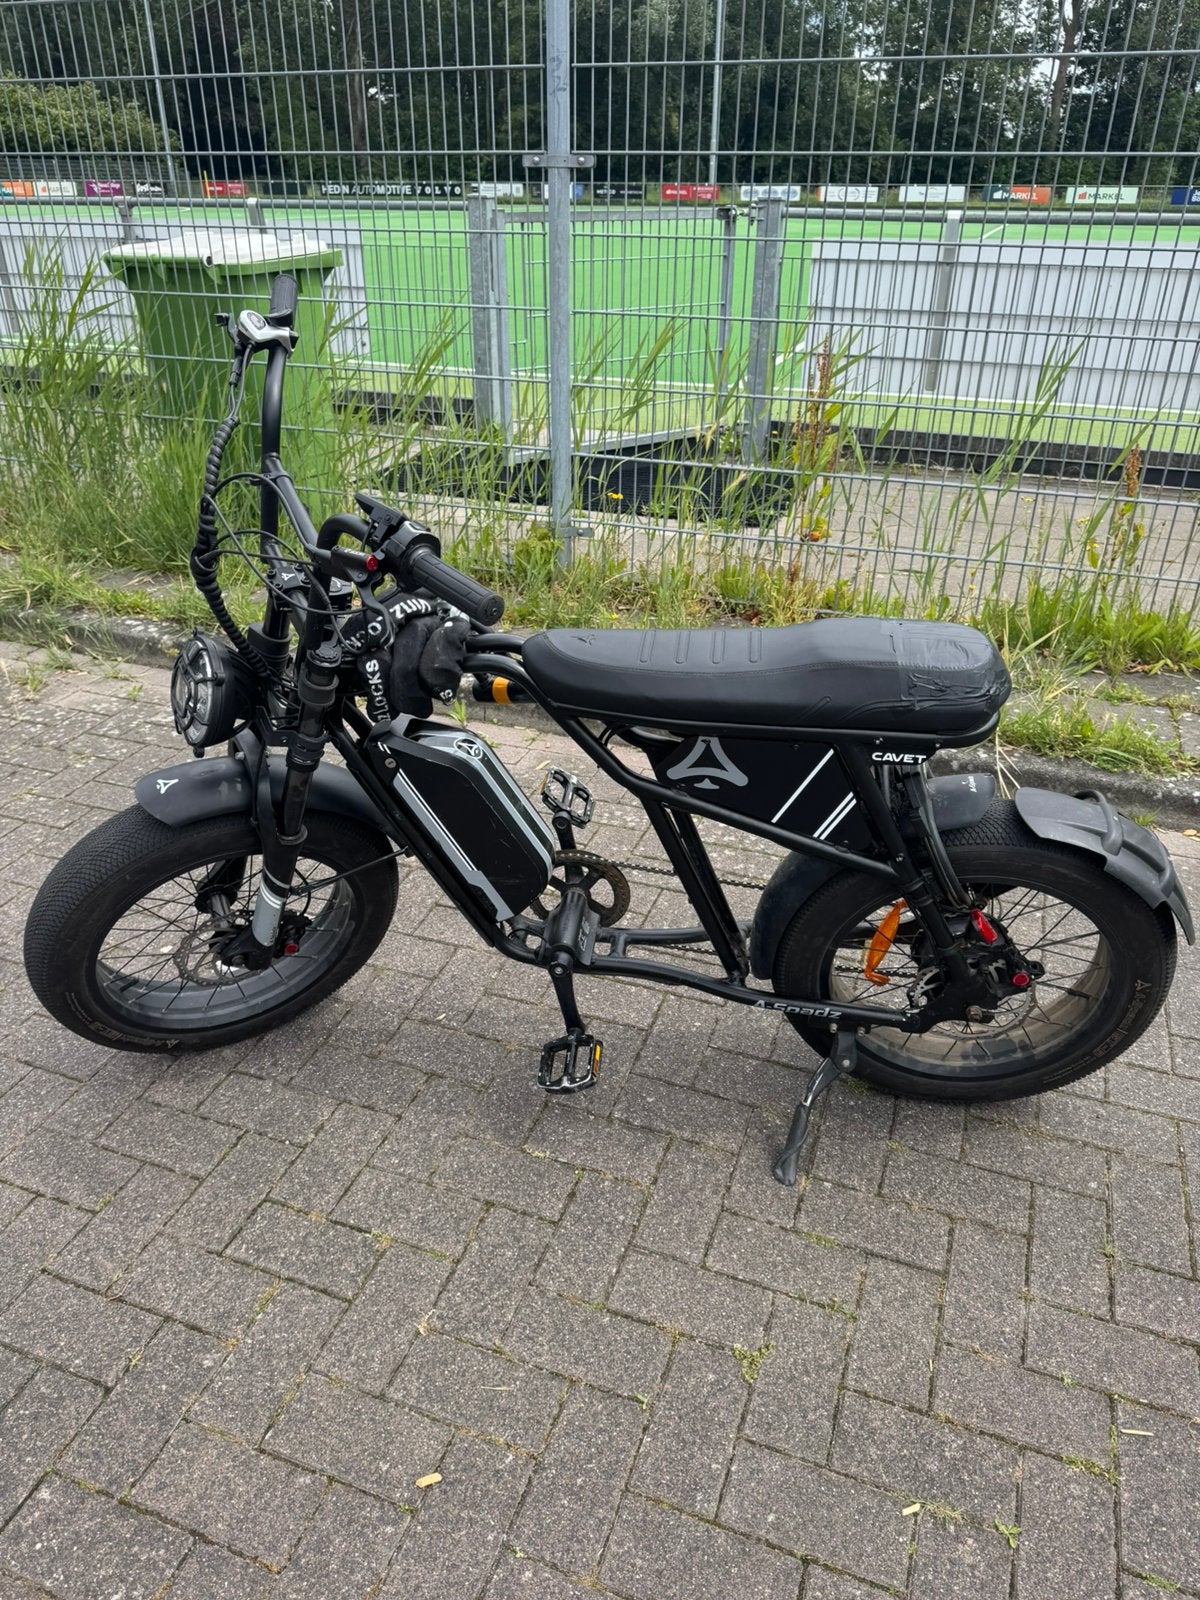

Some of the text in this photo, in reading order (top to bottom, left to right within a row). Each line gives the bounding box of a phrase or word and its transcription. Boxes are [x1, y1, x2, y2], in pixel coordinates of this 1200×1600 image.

[321, 184, 461, 195] HEDN AUTOMOTIVE VOLVO
[1088, 192, 1125, 200] MARKEL
[871, 752, 927, 764] CAVET
